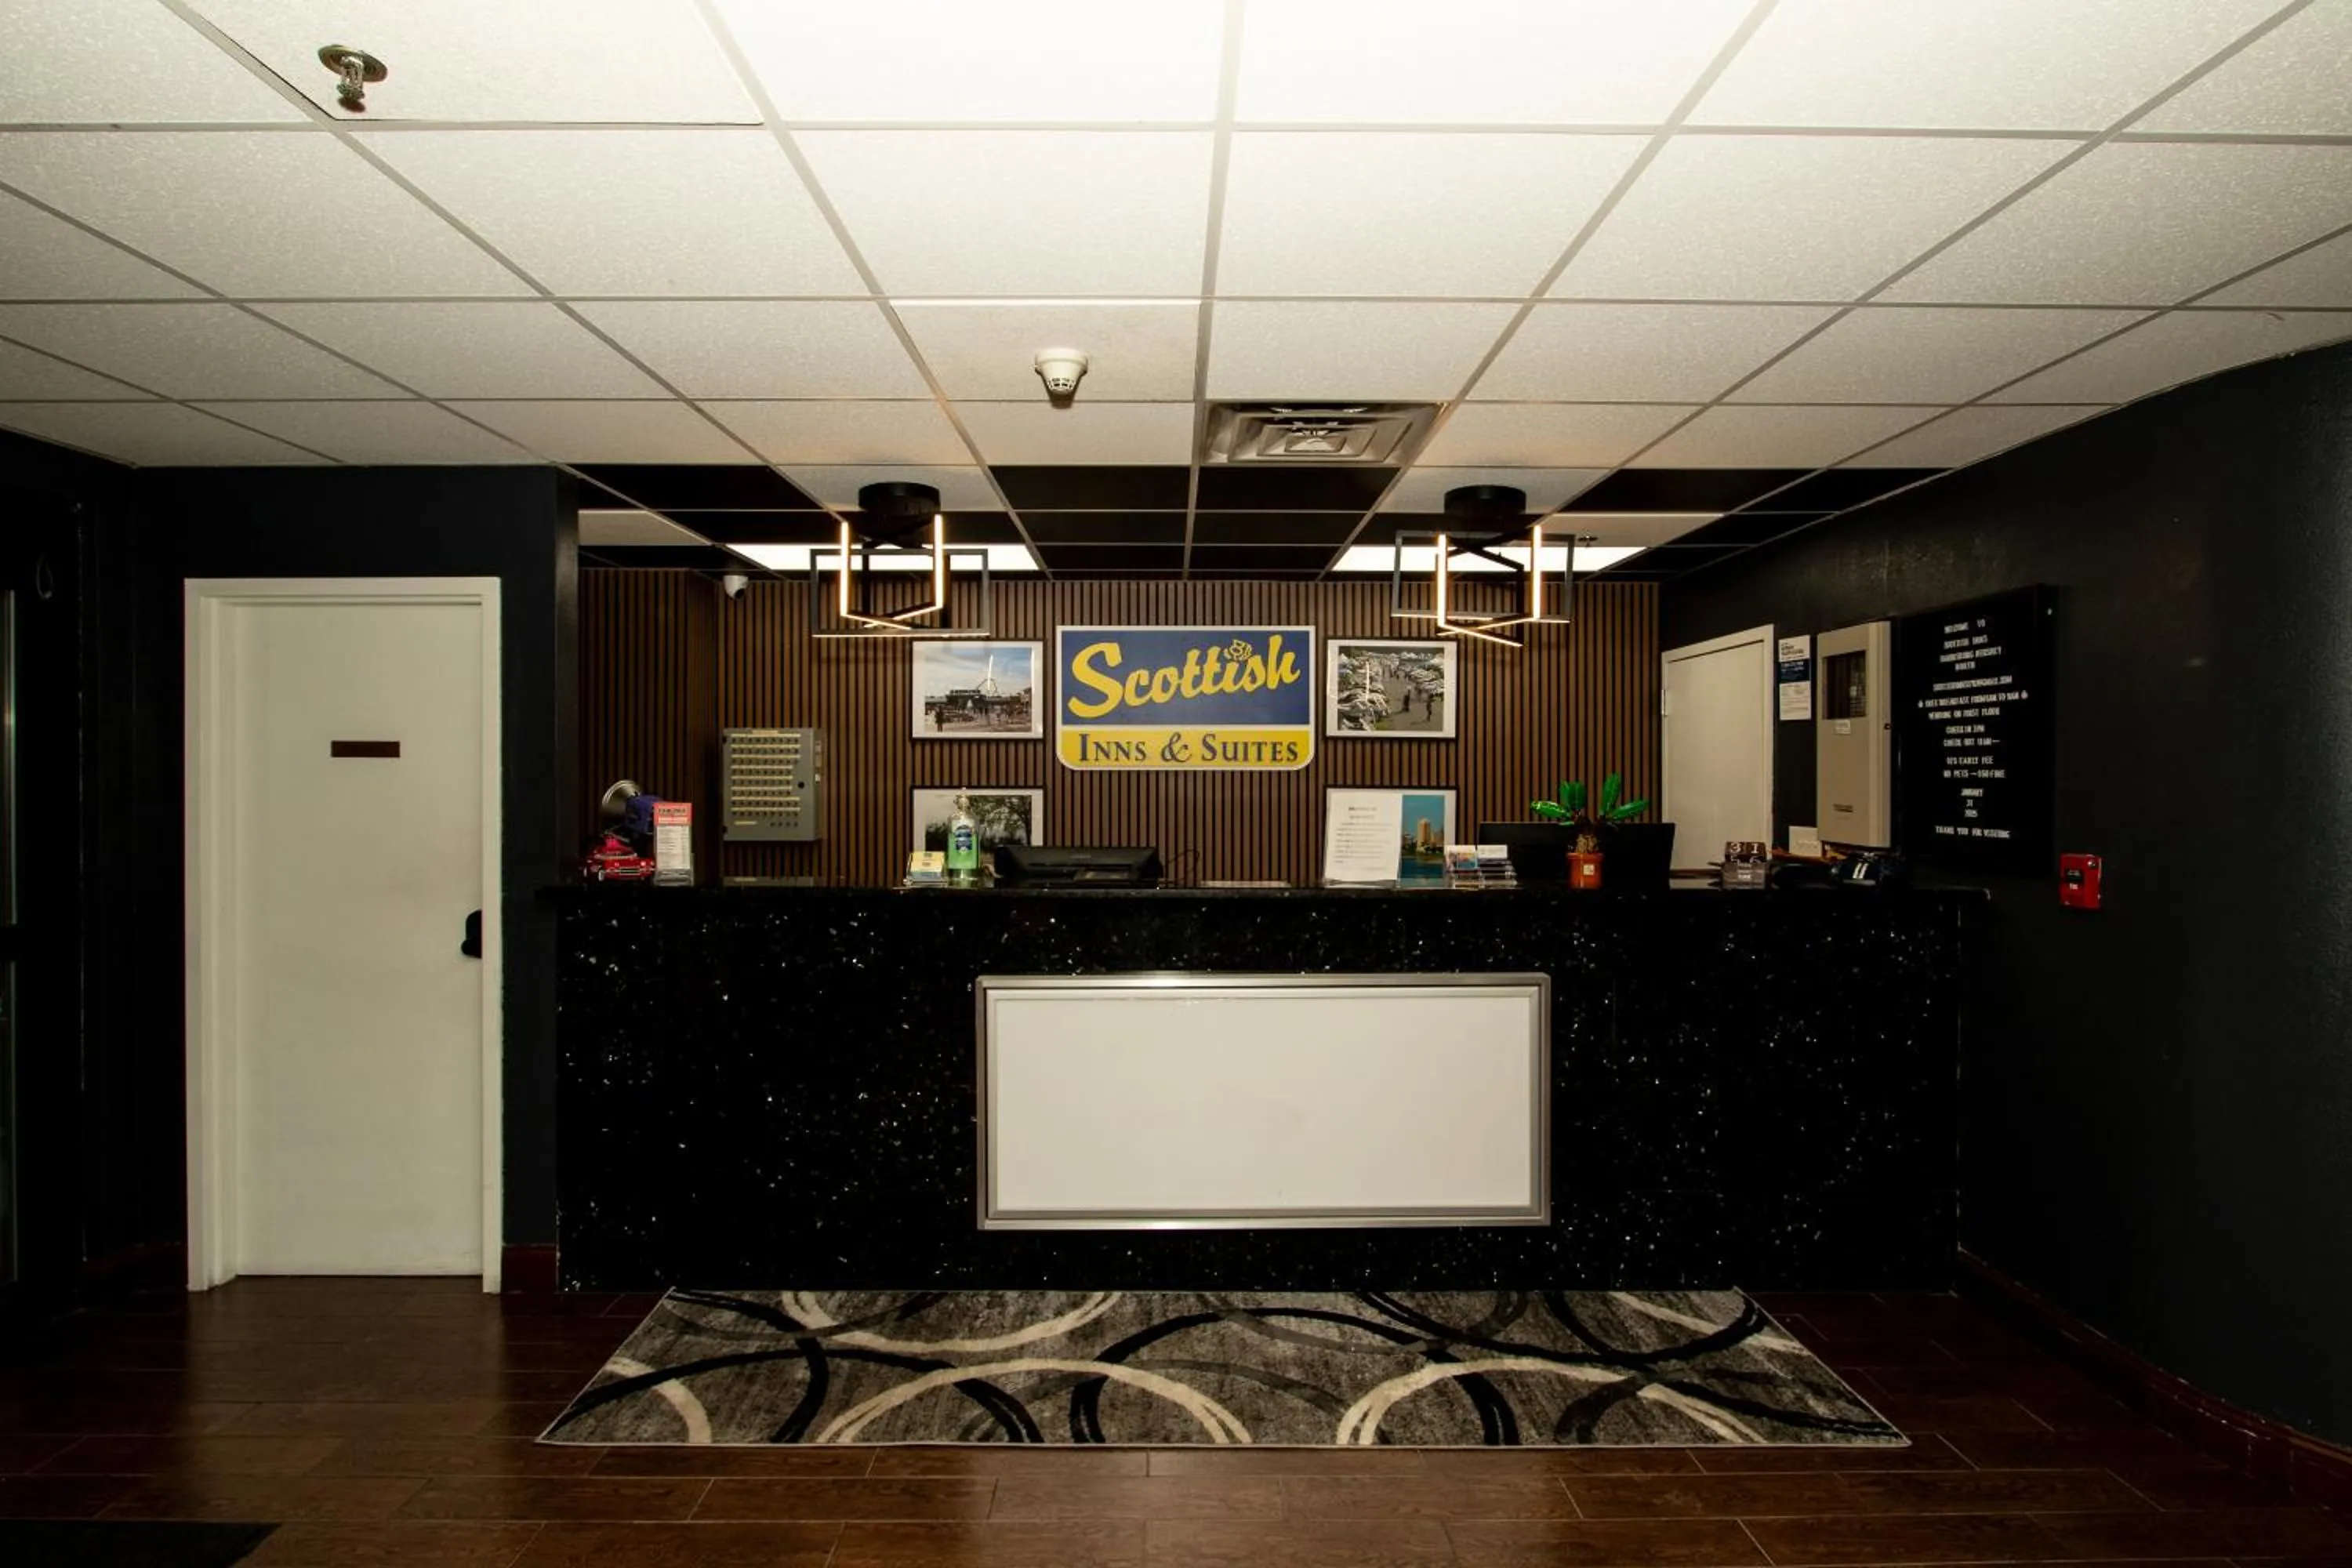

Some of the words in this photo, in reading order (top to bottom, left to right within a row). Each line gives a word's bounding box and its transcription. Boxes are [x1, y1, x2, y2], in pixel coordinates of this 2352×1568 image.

[1067, 633, 1301, 719] Scottish
[1079, 733, 1147, 762] INNS
[1160, 731, 1192, 763] &
[1201, 733, 1299, 763] SUITES
